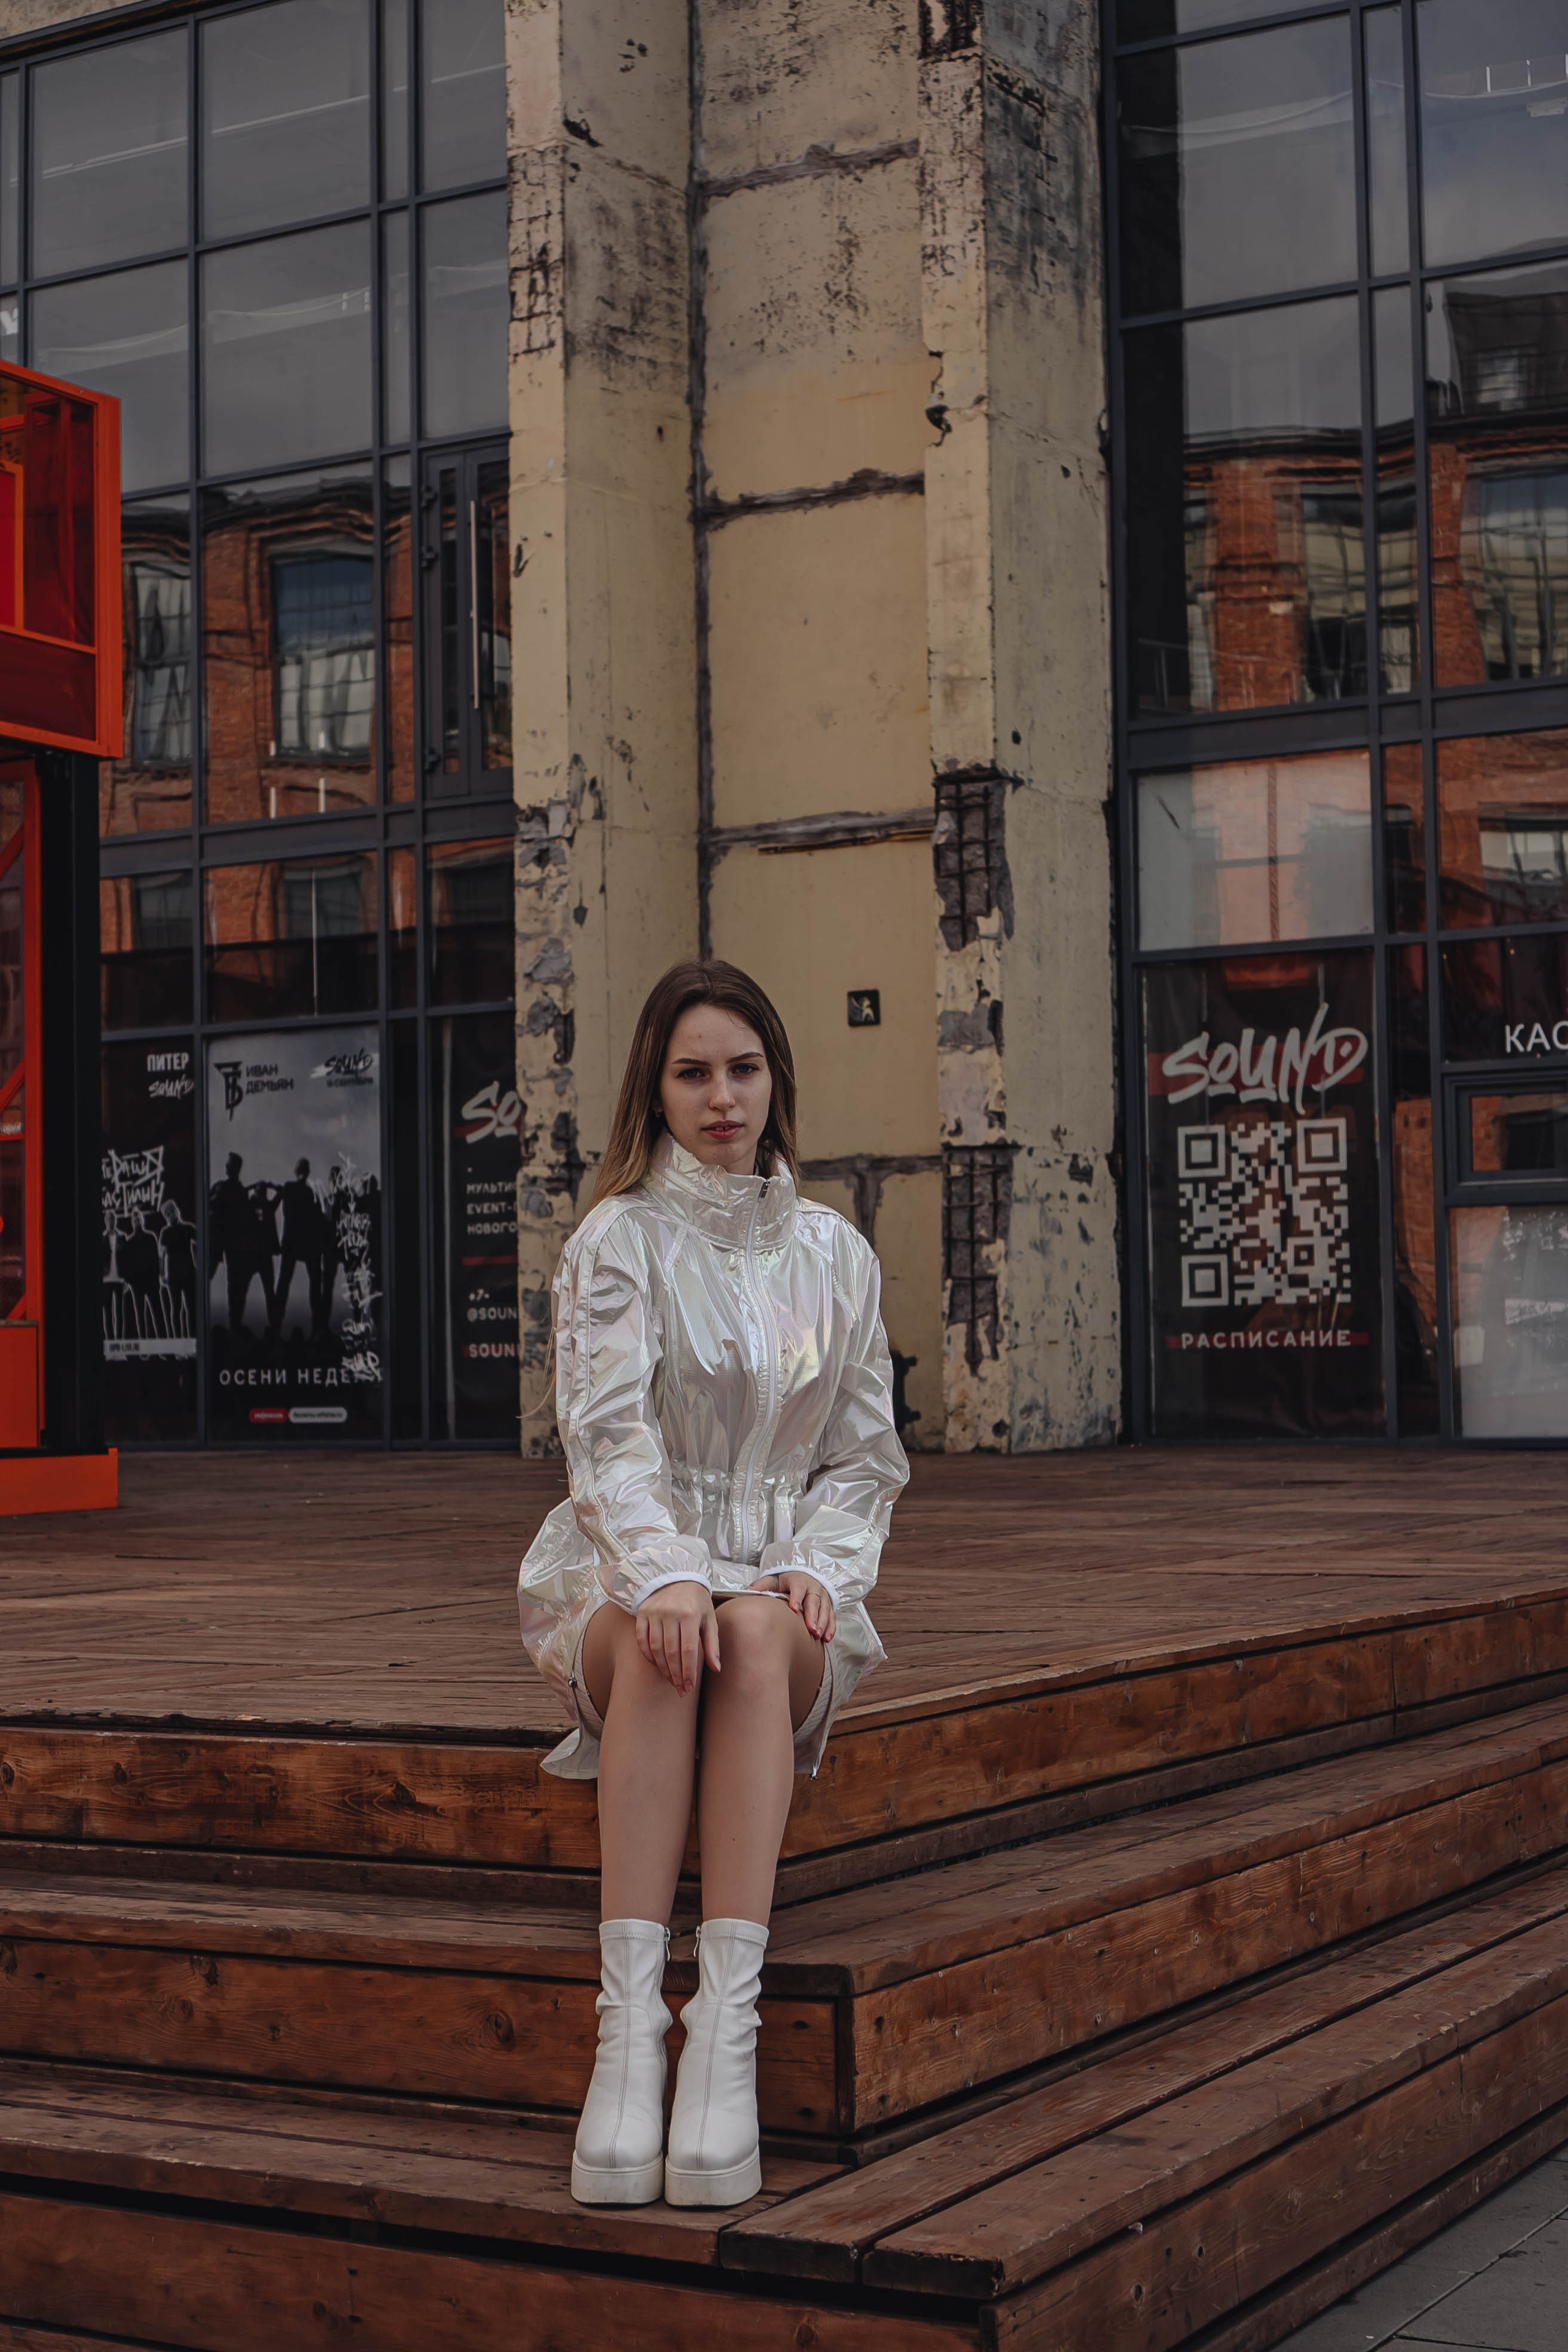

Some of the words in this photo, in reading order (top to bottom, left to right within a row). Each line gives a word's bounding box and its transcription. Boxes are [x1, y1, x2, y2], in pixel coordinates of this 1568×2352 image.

[146, 1052, 189, 1072] ПИТЕР
[1161, 1002, 1368, 1116] SOUND
[246, 1063, 279, 1077] ИВАН
[245, 1078, 294, 1095] ДЕМЬЯН
[1181, 1329, 1352, 1350] РАСПИСАНИЕ
[469, 1343, 519, 1358] SOUN
[219, 1368, 287, 1386] ОСЕНИ
[296, 1367, 382, 1387] НЕДЕ
